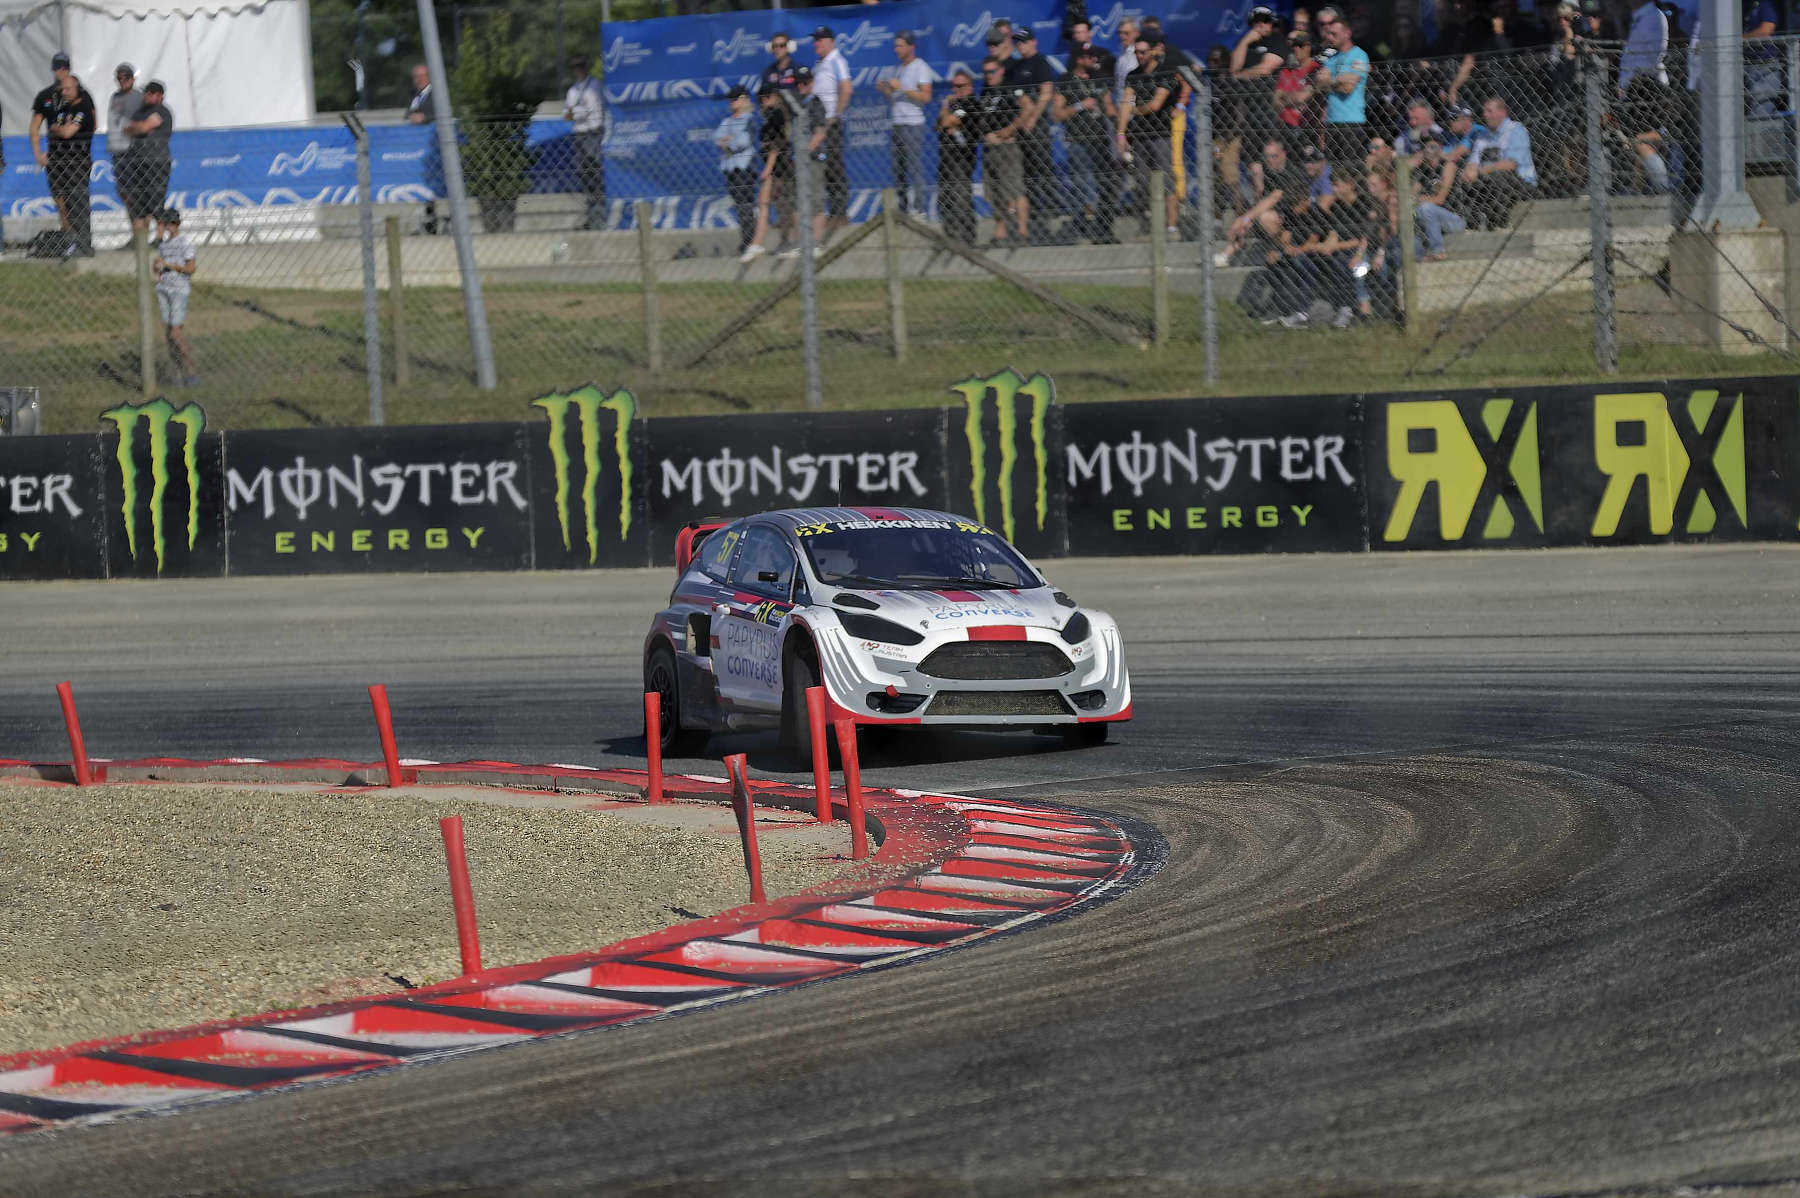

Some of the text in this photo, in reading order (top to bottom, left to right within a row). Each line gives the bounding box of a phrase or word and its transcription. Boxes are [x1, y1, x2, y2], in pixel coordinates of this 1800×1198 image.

[661, 446, 928, 507] MONSTER
[1065, 428, 1355, 497] MONSTER
[227, 455, 529, 520] MONSTER
[837, 520, 951, 531] HEIKKINEN
[1112, 505, 1313, 530] ENERGY
[275, 527, 484, 553] ENERGY
[716, 530, 740, 564] 57
[727, 623, 779, 661] PAPYRUS
[727, 655, 778, 689] CONVERSE
